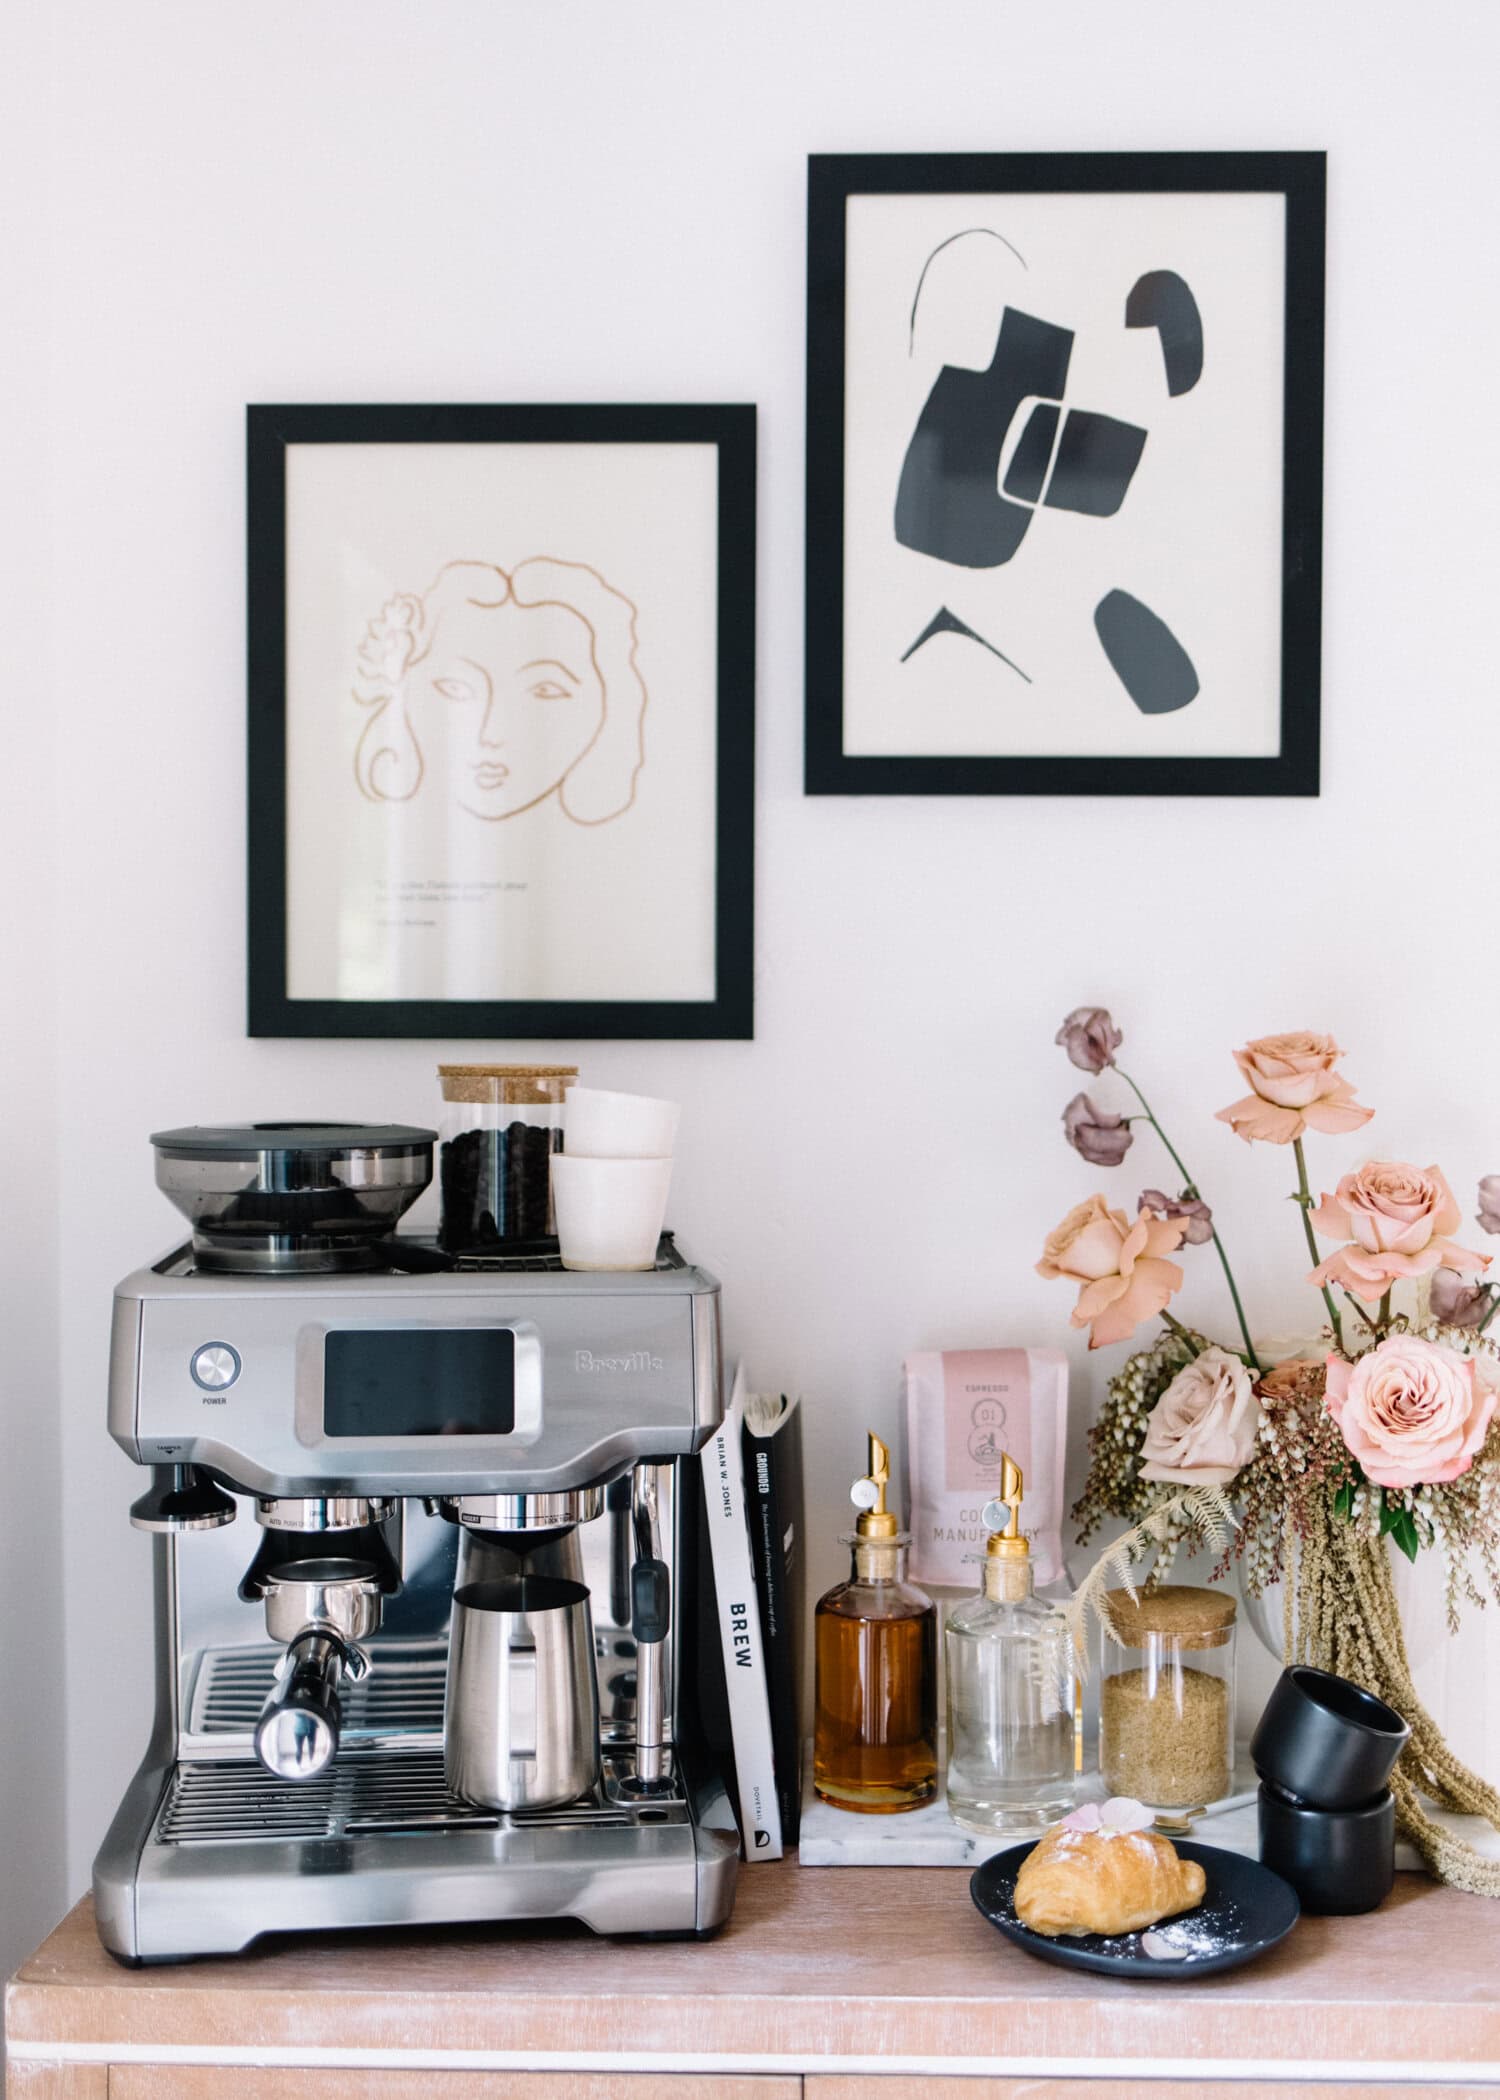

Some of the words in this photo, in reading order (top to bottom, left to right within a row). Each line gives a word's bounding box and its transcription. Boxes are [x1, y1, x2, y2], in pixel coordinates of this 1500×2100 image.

[575, 1350, 664, 1372] Breville
[965, 1384, 1009, 1393] ESPRESSO
[202, 1397, 227, 1405] POWER
[717, 1437, 727, 1467] BRIAN
[722, 1486, 732, 1518] JONES
[756, 1452, 770, 1494] GROUNDED
[933, 1527, 1040, 1541] MANUFRY
[730, 1602, 752, 1668] BREW
